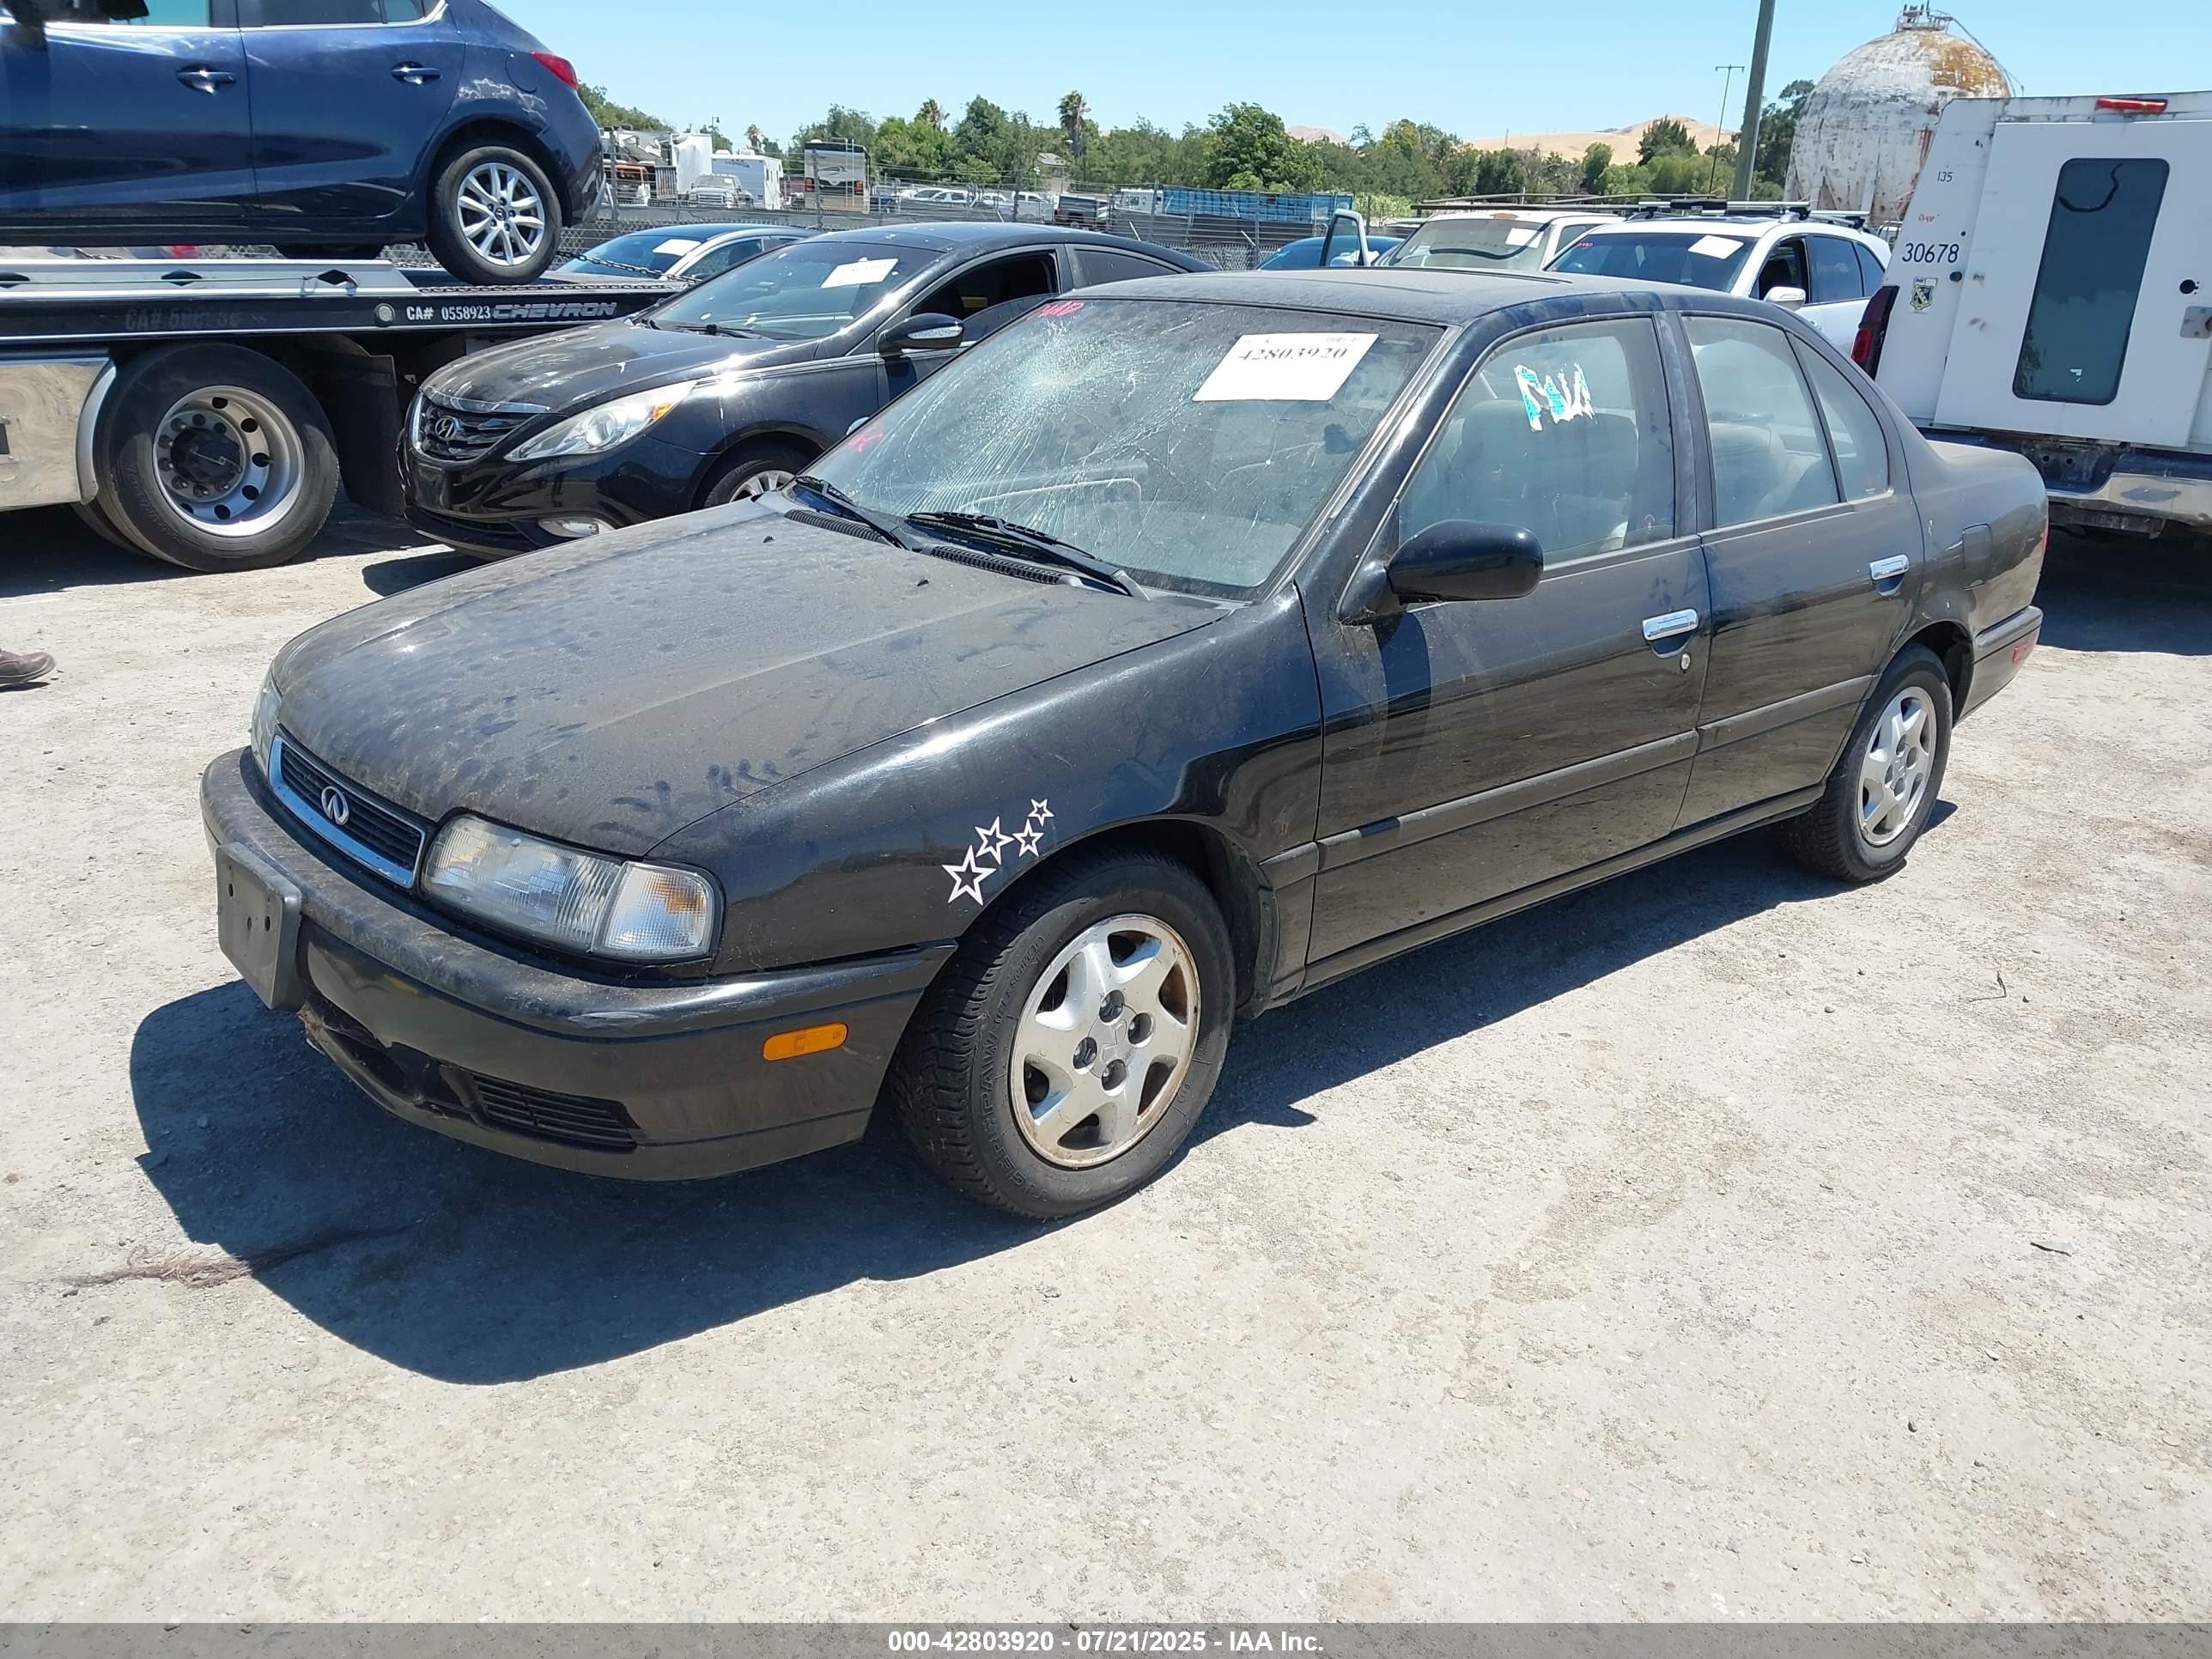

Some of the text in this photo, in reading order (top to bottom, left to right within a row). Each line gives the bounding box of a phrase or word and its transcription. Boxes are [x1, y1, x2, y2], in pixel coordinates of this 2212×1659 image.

[1937, 171, 1954, 183] 135
[1902, 242, 1960, 264] 30678
[406, 306, 491, 321] CA# 0558923
[493, 302, 617, 319] CHEVRON
[1237, 347, 1348, 362] 42803920
